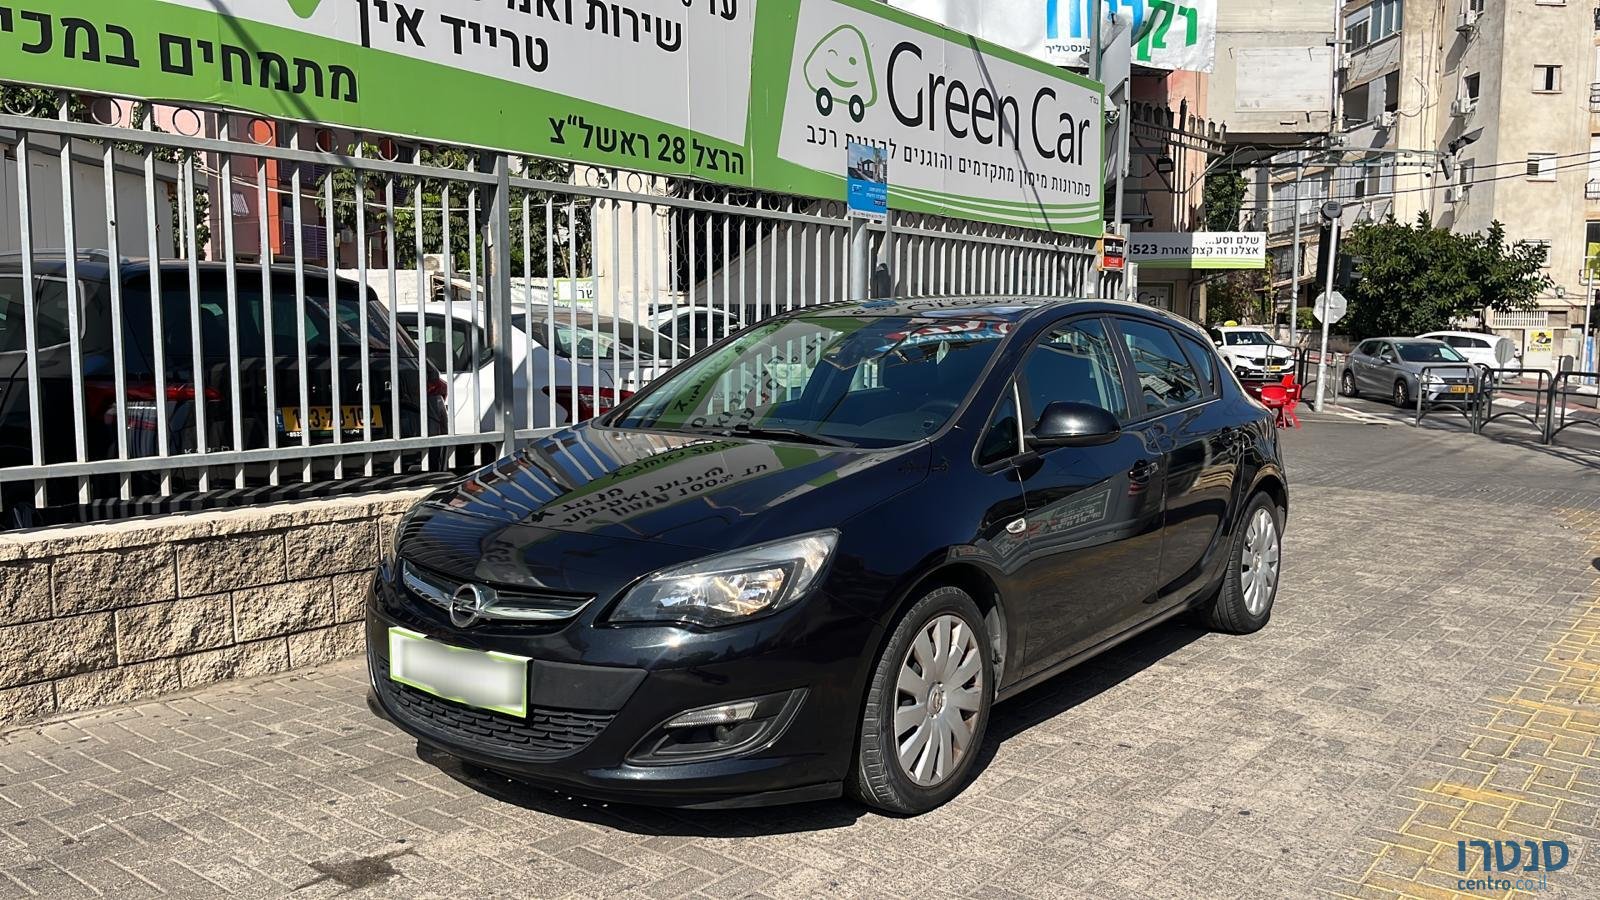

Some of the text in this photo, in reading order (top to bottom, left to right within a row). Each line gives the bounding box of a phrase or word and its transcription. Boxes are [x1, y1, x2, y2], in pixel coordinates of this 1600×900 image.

[357, 0, 549, 72] טרייד אין
[585, 0, 682, 52] שירות
[159, 32, 358, 103] מתמחים
[887, 41, 1090, 166] Green Car
[656, 132, 686, 164] 28
[806, 124, 837, 148] רכב
[692, 137, 744, 175] הרצל
[904, 145, 952, 171] והוגנים
[959, 157, 1014, 183] מתקדמים
[1019, 169, 1047, 189] מימון
[1051, 176, 1091, 197] פתרונות
[1161, 246, 1189, 255] אחרת
[1191, 246, 1213, 257] קצת
[1216, 246, 1227, 255] זה
[1231, 245, 1258, 255] אצלנו
[1236, 235, 1259, 245] שלם
